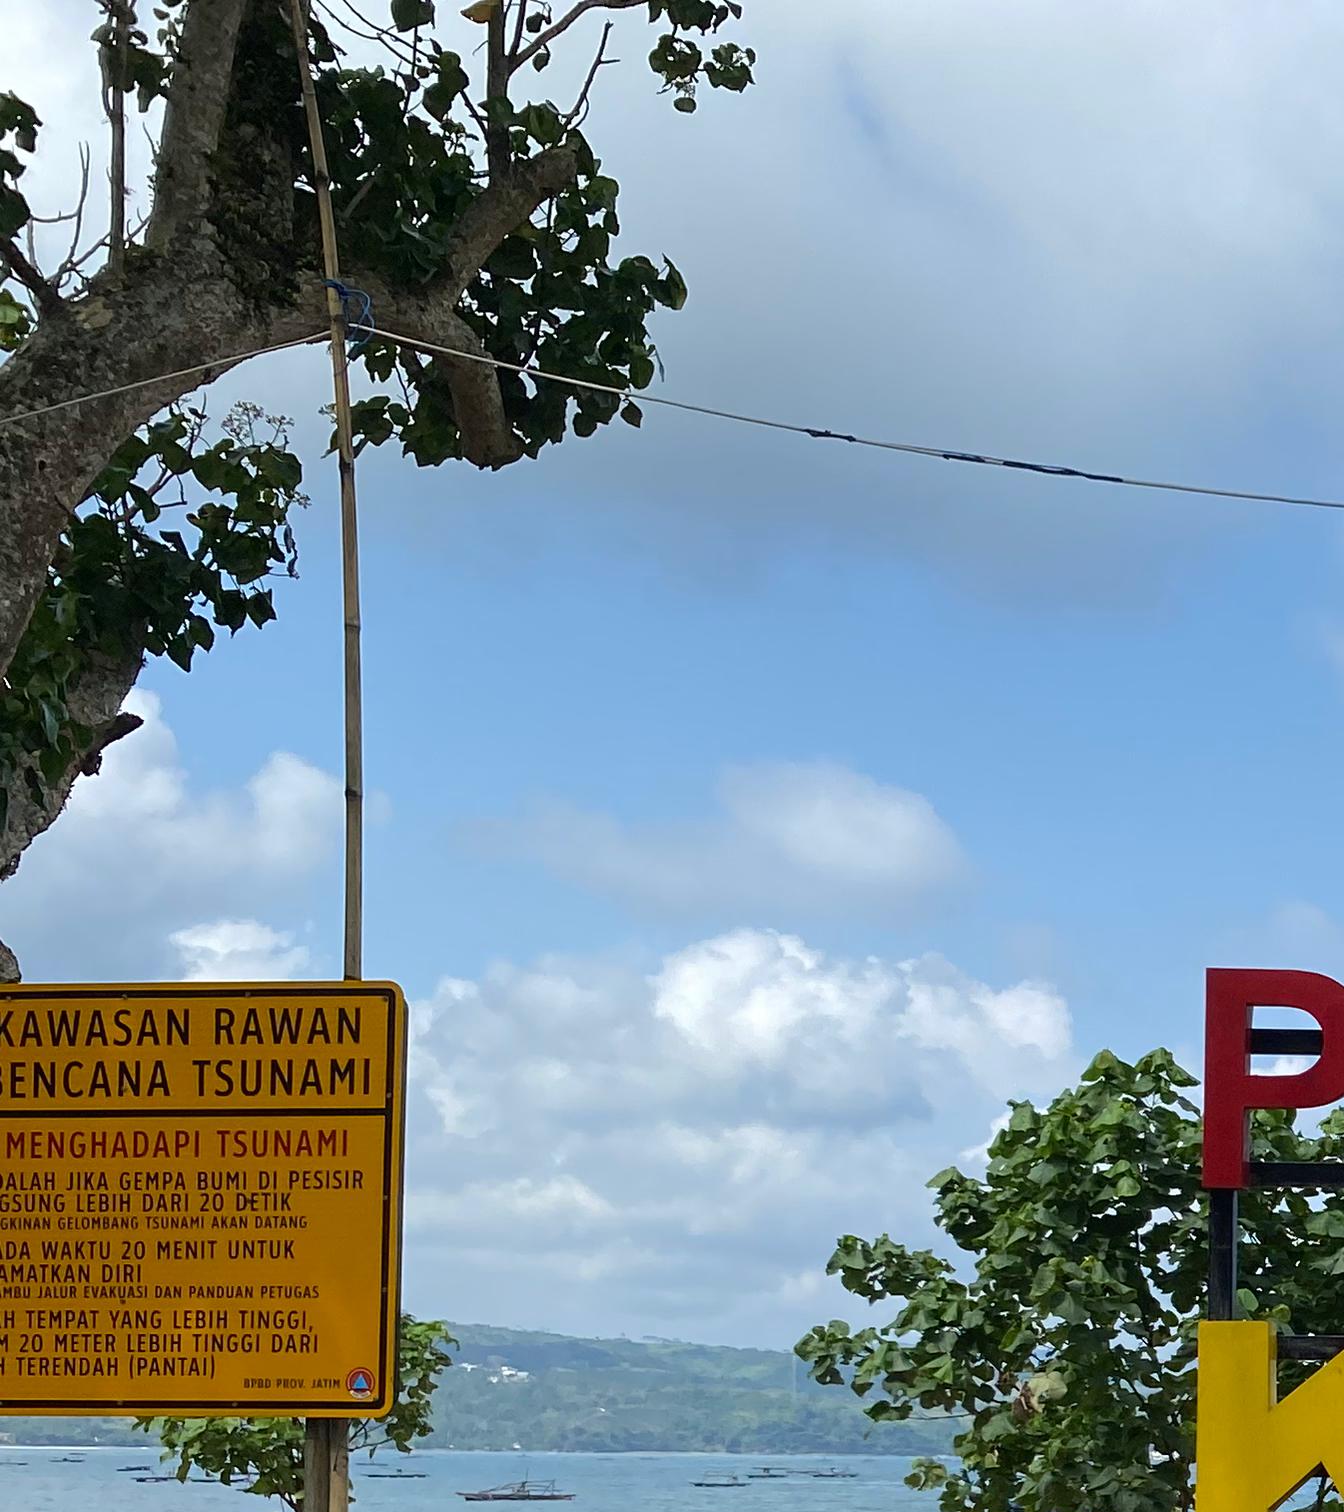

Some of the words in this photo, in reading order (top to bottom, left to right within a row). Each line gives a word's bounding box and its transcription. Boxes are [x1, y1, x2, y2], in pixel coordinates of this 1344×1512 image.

[214, 1007, 362, 1045] RAWAN
[192, 1058, 371, 1097] TSUNAMI
[6, 1130, 200, 1159] MENGHADAPI
[216, 1129, 348, 1158] TSUNAMI
[66, 1172, 108, 1191] JIKA
[119, 1172, 186, 1191] GEMPA
[197, 1171, 247, 1190] BUMI
[258, 1171, 278, 1190] DI
[289, 1170, 364, 1189] PESISIR
[76, 1193, 131, 1212] LEBIH
[143, 1193, 189, 1212] DARI
[200, 1193, 225, 1212] 20
[236, 1192, 292, 1212] DETIK
[58, 1217, 138, 1230] GELOMBANG
[145, 1216, 204, 1230] TSUNAMI
[211, 1215, 248, 1229] AKAN
[255, 1215, 308, 1229] DATANG
[0, 1241, 31, 1260] DA
[42, 1241, 110, 1260] WAKTU
[121, 1241, 146, 1260] 20
[157, 1240, 217, 1260] MENIT
[228, 1240, 295, 1259] UNTUK
[102, 1264, 142, 1283] DIRI
[0, 1286, 31, 1298] MBU
[38, 1286, 77, 1298] JALUR
[84, 1286, 148, 1298] EVAKUASI
[155, 1286, 182, 1298] DAN
[189, 1286, 253, 1298] PANDUAN
[261, 1286, 319, 1298] PETUGAS
[26, 1310, 99, 1329] TEMPAT
[109, 1310, 161, 1329] YANG
[173, 1310, 228, 1329] LEBIH
[239, 1310, 314, 1332] TINGGI,
[20, 1334, 43, 1353] 20
[55, 1334, 116, 1353] METER
[127, 1334, 182, 1353] LEBIH
[193, 1334, 260, 1353] TINGGI
[272, 1334, 318, 1353] DARI
[16, 1357, 118, 1376] TERENDAH
[129, 1355, 215, 1379] (PANTAI)
